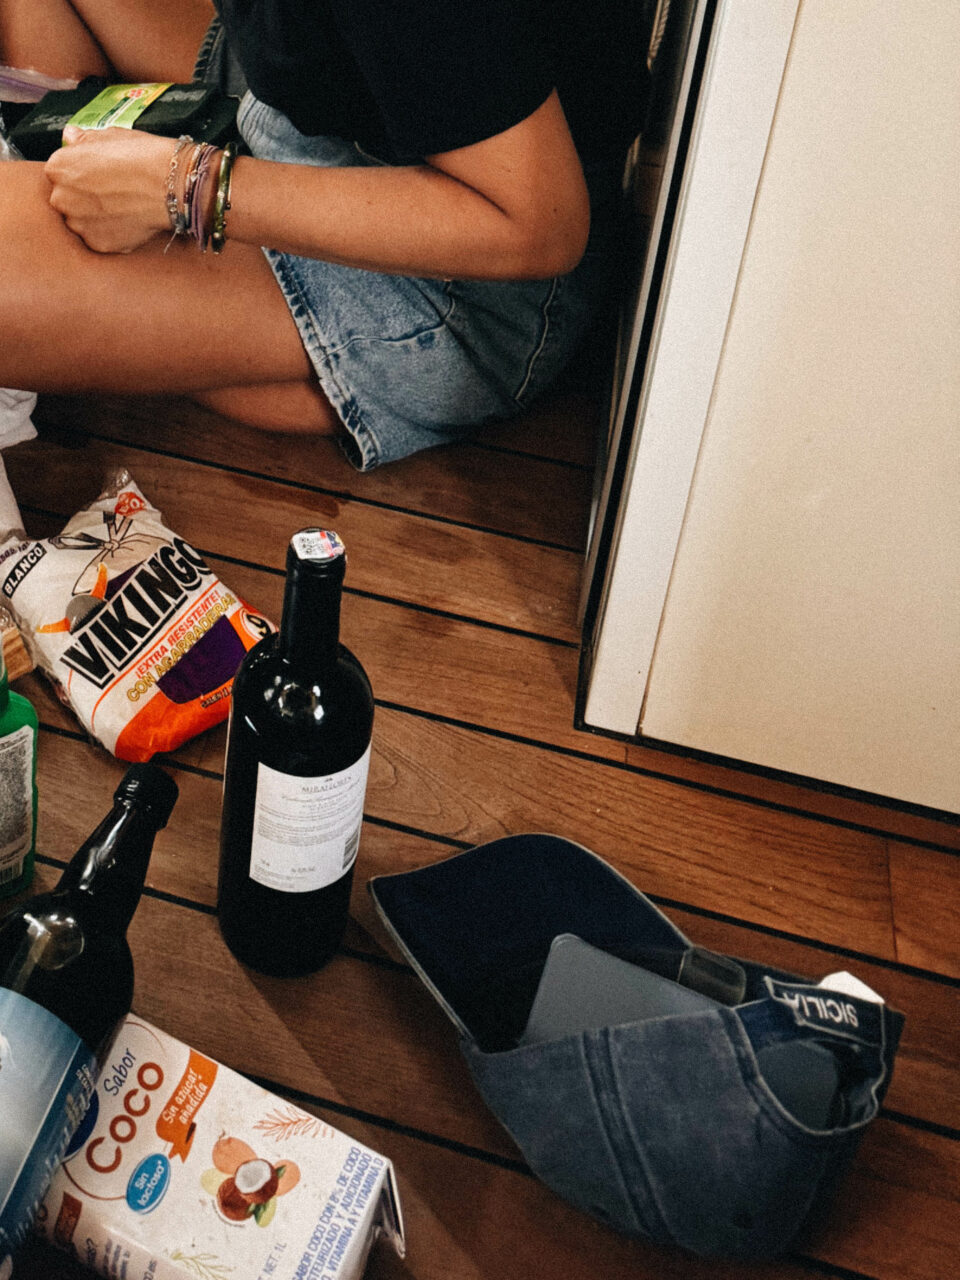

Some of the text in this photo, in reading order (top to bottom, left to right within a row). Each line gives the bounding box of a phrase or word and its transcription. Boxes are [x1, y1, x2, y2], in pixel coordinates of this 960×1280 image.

[4, 545, 44, 595] BLANCO
[167, 590, 220, 647] RESISTENTE!
[127, 672, 155, 702] CON
[104, 1048, 137, 1096] Sabor
[85, 1062, 164, 1174] Coco
[162, 1097, 182, 1125] Sin
[342, 1146, 362, 1173] COCO
[373, 1157, 384, 1168] D
[135, 1171, 149, 1190] Sin
[336, 1172, 349, 1187] DE
[340, 1152, 373, 1211] ADICIONADO
[354, 1166, 380, 1209] VITAMINA
[319, 1202, 336, 1225] CON
[335, 1211, 346, 1221] Y
[347, 1217, 359, 1228] A
[350, 1208, 361, 1218] Y
[307, 1224, 326, 1252] COCO
[326, 1226, 355, 1272] VITAMINA
